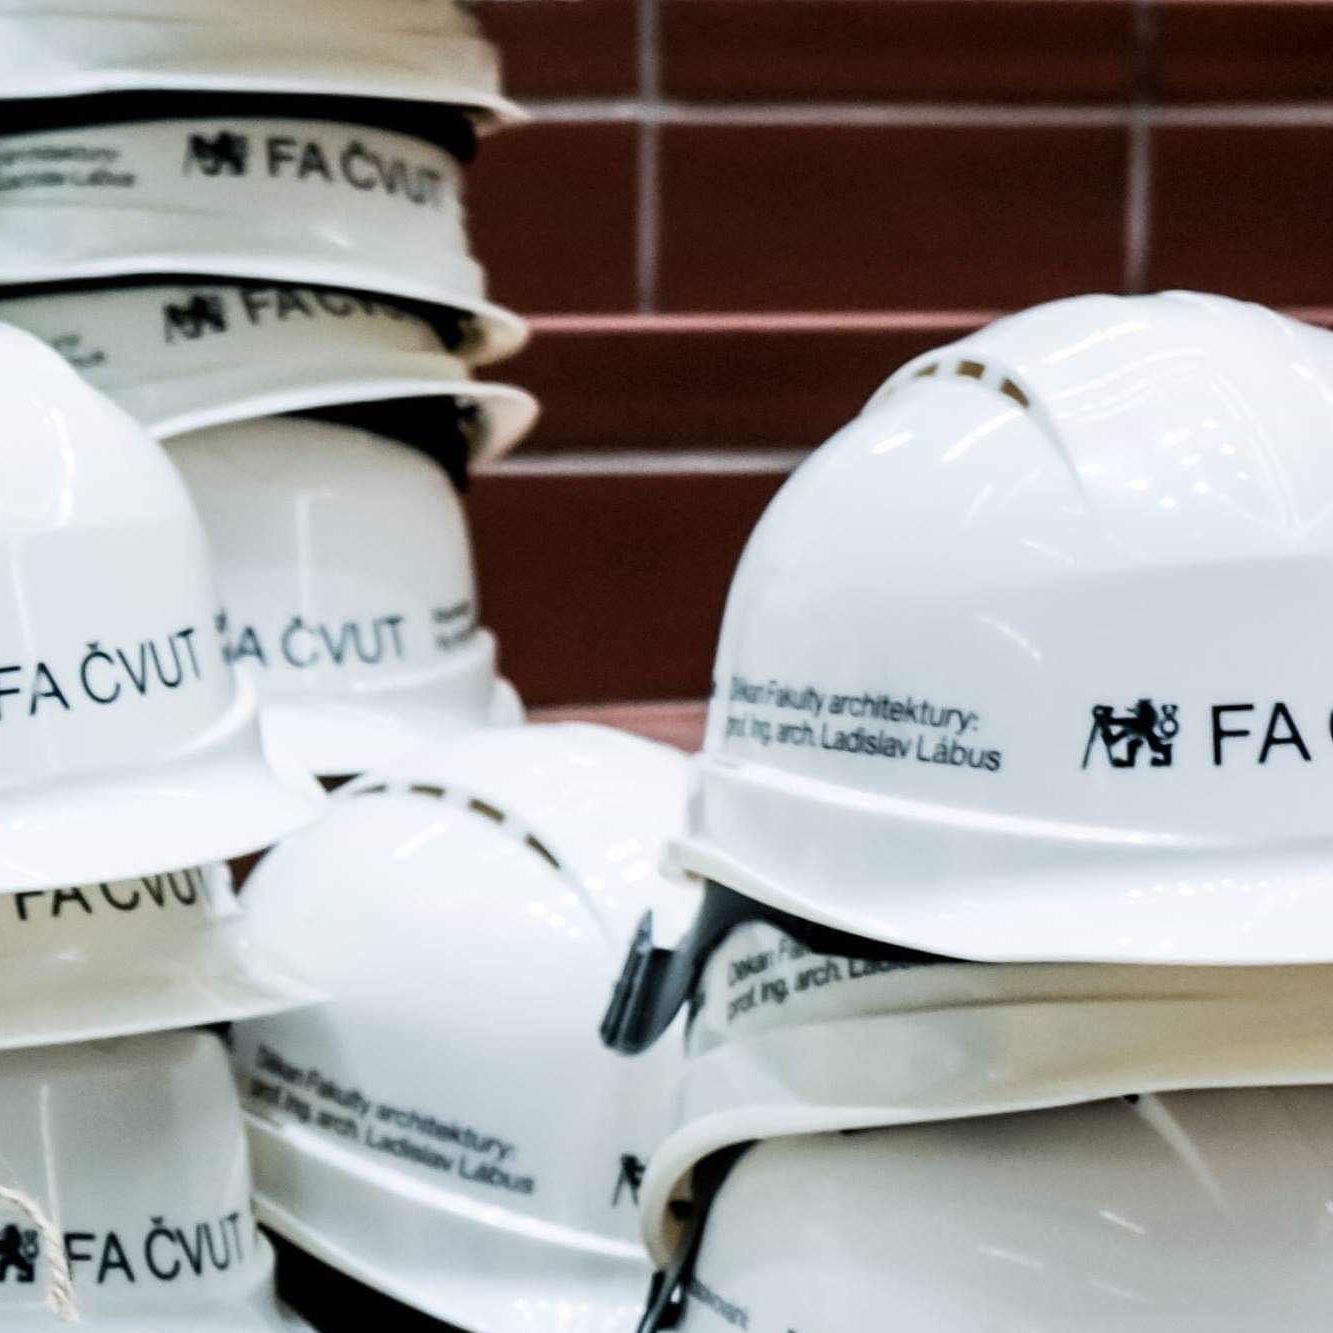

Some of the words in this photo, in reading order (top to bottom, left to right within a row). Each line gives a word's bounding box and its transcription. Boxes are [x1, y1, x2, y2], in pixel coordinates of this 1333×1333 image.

[267, 137, 334, 184] FA
[79, 626, 204, 705] ČVUT
[281, 614, 404, 669] ČVUT
[830, 690, 980, 735] architektury:
[1211, 702, 1312, 766] FA
[821, 722, 912, 759] Ladislav
[916, 734, 1002, 772] Lábus
[145, 1213, 244, 1283] ČVUT
